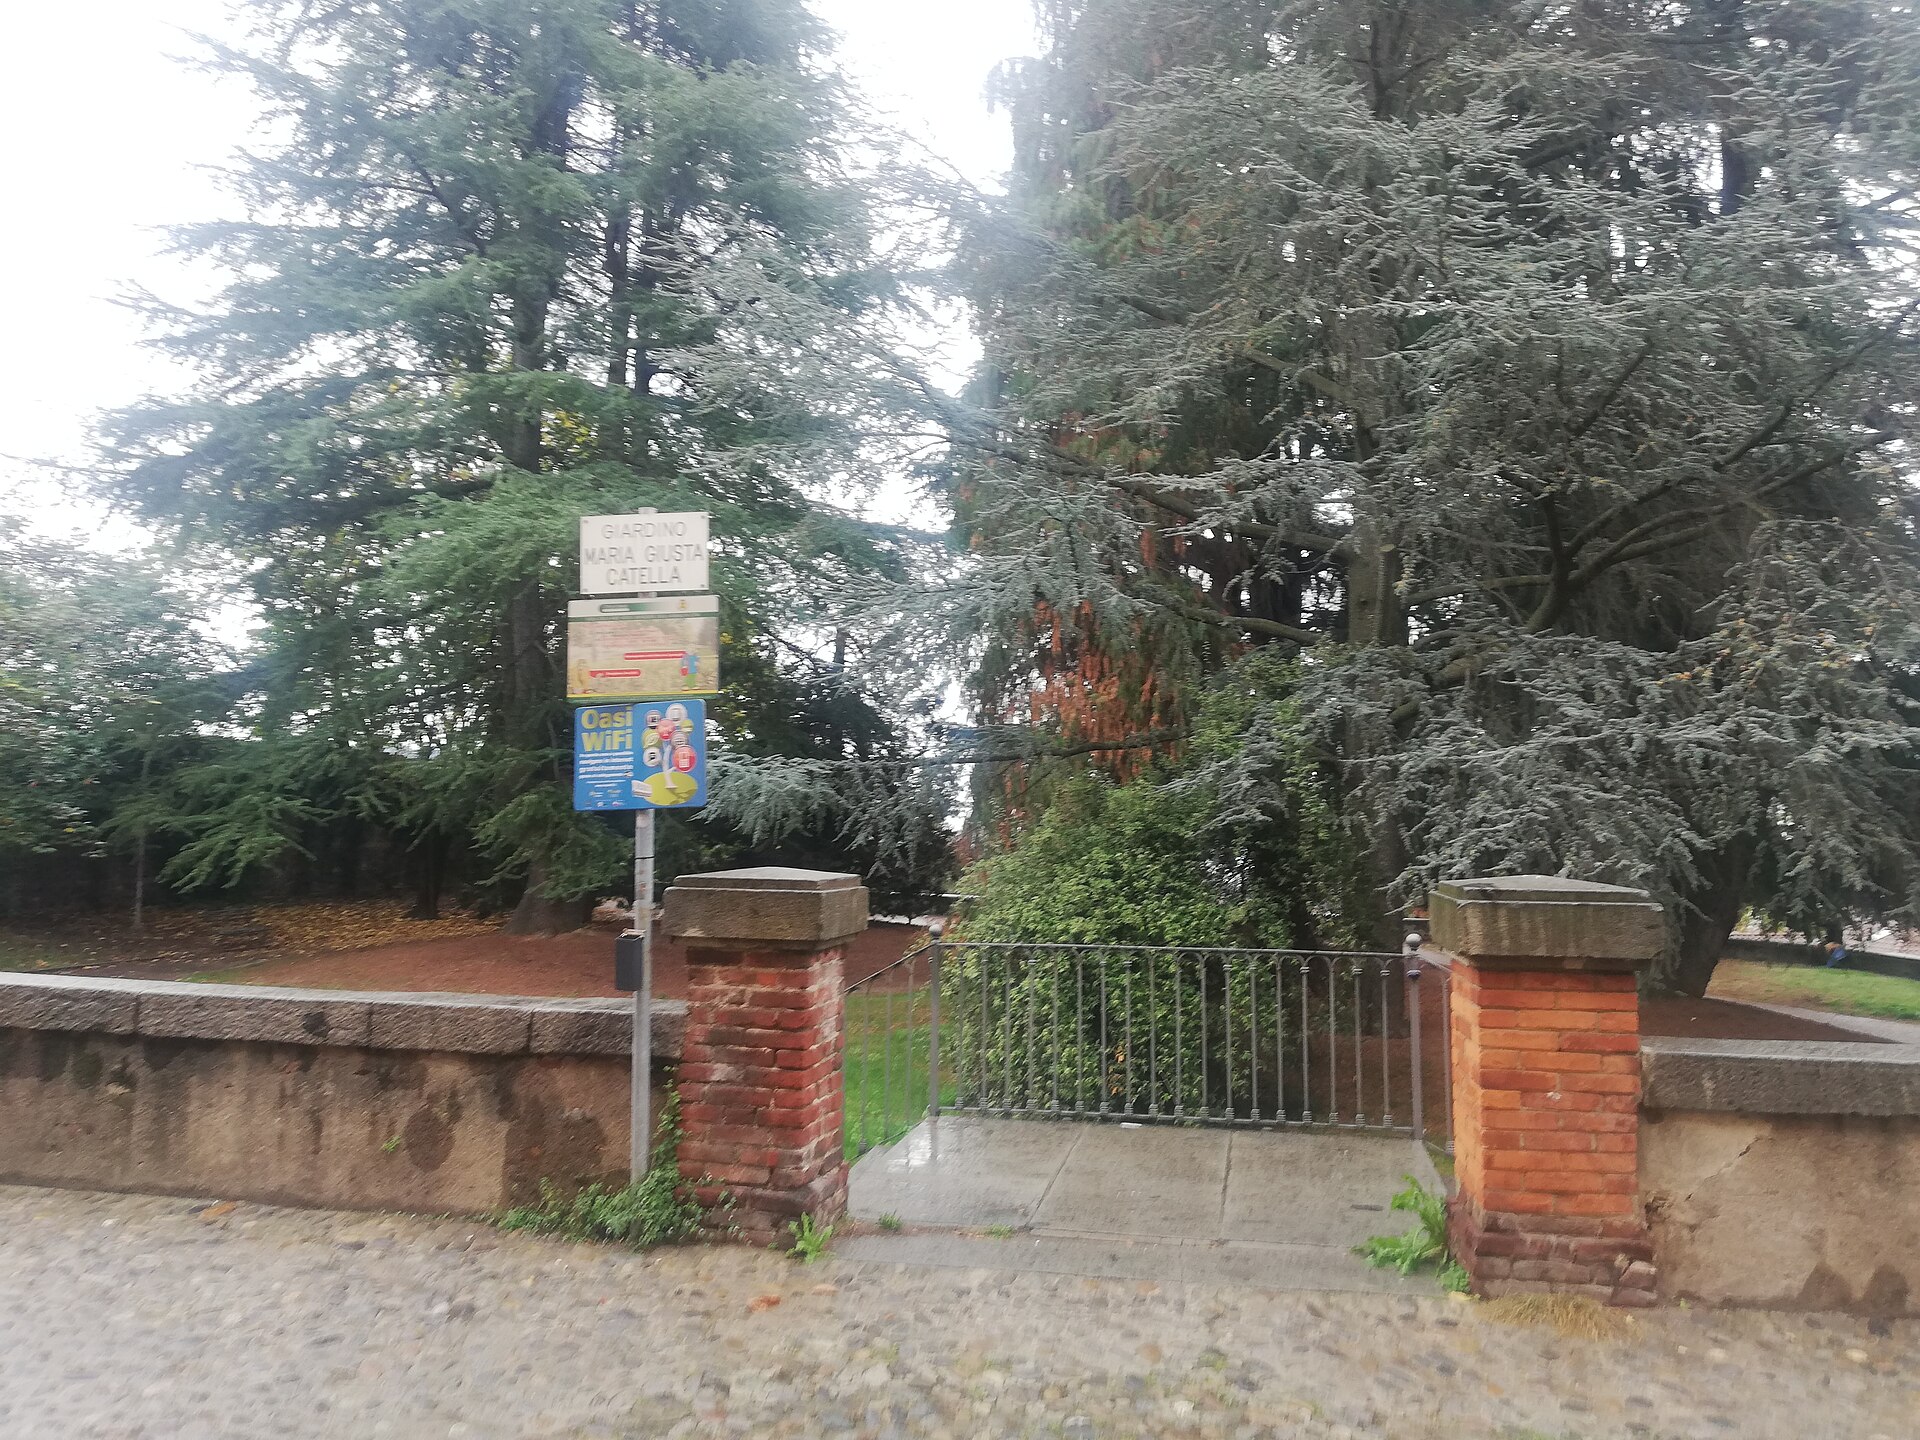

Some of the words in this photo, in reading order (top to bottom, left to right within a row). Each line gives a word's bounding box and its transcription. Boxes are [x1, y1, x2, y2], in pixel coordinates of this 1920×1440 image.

[601, 521, 687, 539] GIARDINO
[584, 547, 635, 565] MARIA
[644, 544, 704, 563] GIUSTA
[606, 565, 682, 586] CATELLA
[581, 706, 633, 729] Oasi
[581, 729, 633, 752] WiFi
